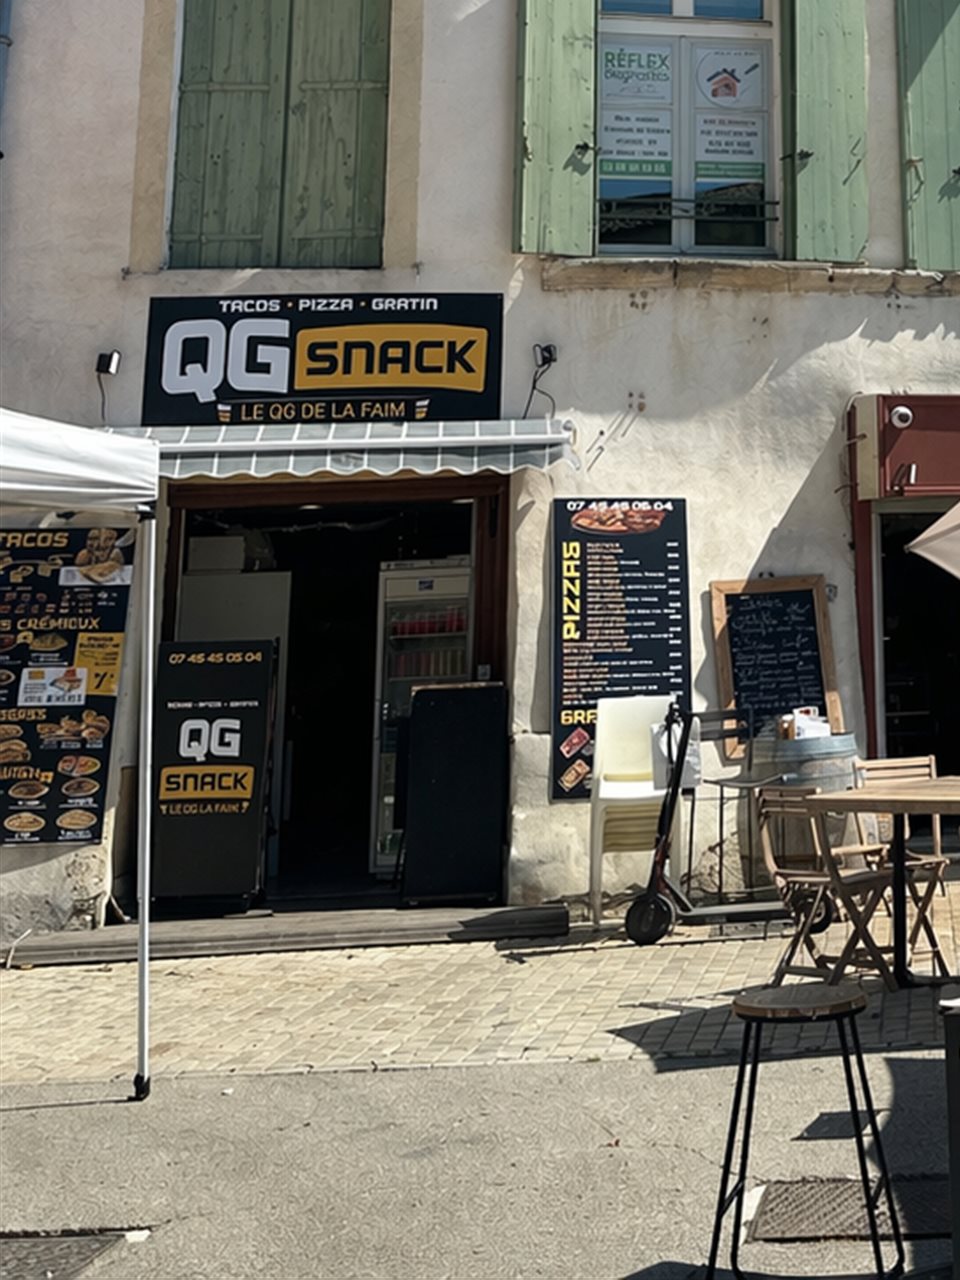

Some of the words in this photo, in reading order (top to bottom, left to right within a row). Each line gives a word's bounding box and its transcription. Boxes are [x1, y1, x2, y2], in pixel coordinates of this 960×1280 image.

[604, 48, 670, 71] RÉFLEX
[219, 299, 281, 313] TACOS
[298, 298, 354, 312] PIZZA
[371, 297, 438, 311] GRATIN
[161, 318, 291, 403] QG
[306, 339, 477, 376] SNACK
[241, 404, 264, 421] LE
[269, 403, 296, 420] QG
[301, 403, 326, 419] DE
[331, 403, 359, 418] LA
[362, 402, 405, 418] FAIM
[566, 500, 586, 512] 07
[653, 500, 674, 512] 04
[562, 541, 580, 640] PIZZAS
[168, 652, 186, 665] 07
[179, 718, 241, 762] QG
[165, 772, 248, 792] SNACK
